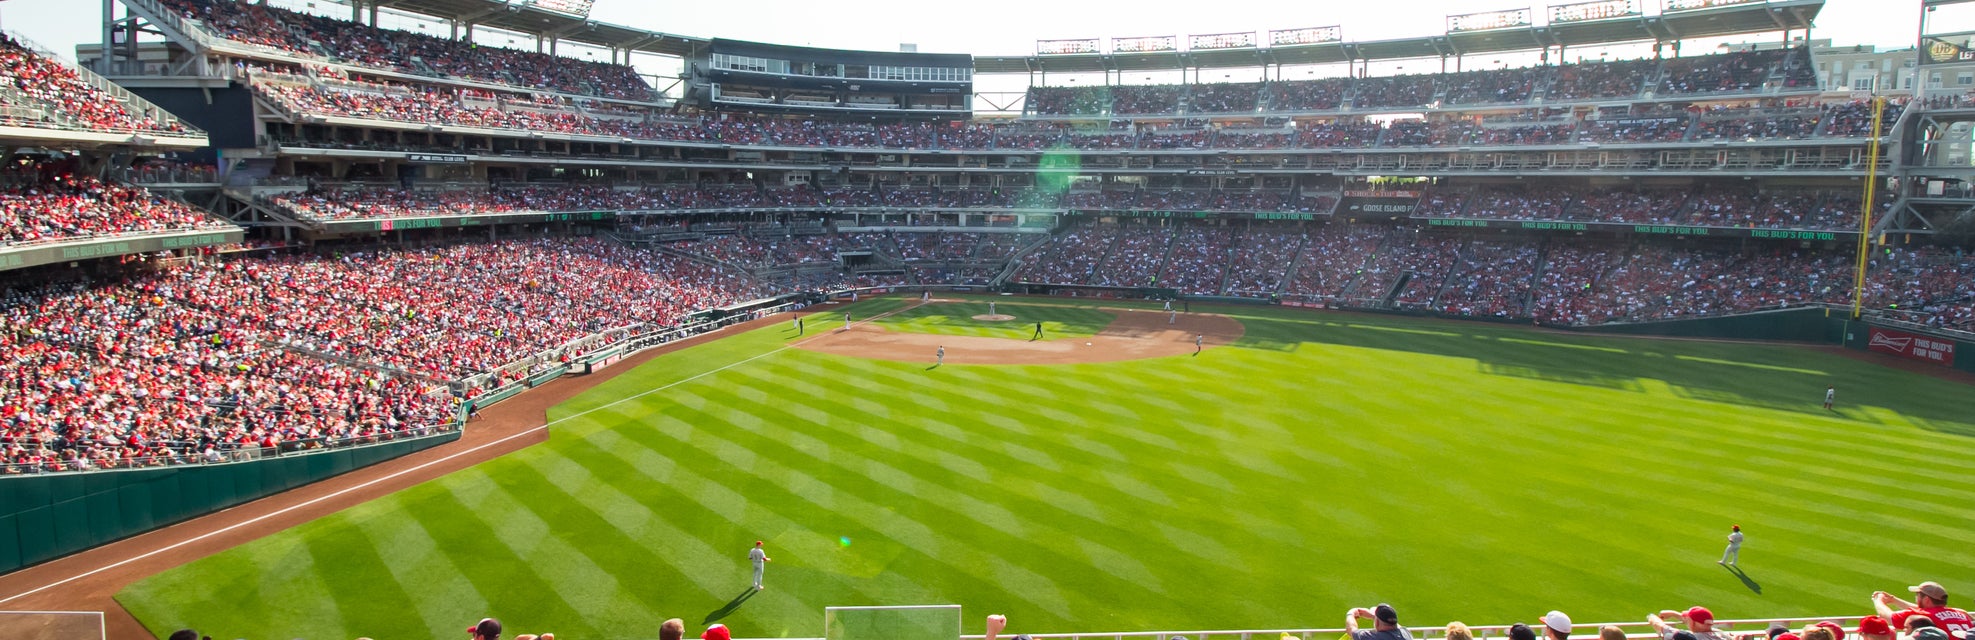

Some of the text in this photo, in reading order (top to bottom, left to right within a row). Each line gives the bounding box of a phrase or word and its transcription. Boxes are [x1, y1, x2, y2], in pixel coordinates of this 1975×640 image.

[1363, 204, 1382, 212] GOOSE
[1384, 204, 1407, 212] ISLAND
[1750, 229, 1837, 241] THIS BUD'S FOR YOU.
[1914, 338, 1953, 353] THIS BUD'S
[1913, 347, 1944, 361] FOR YOU.
